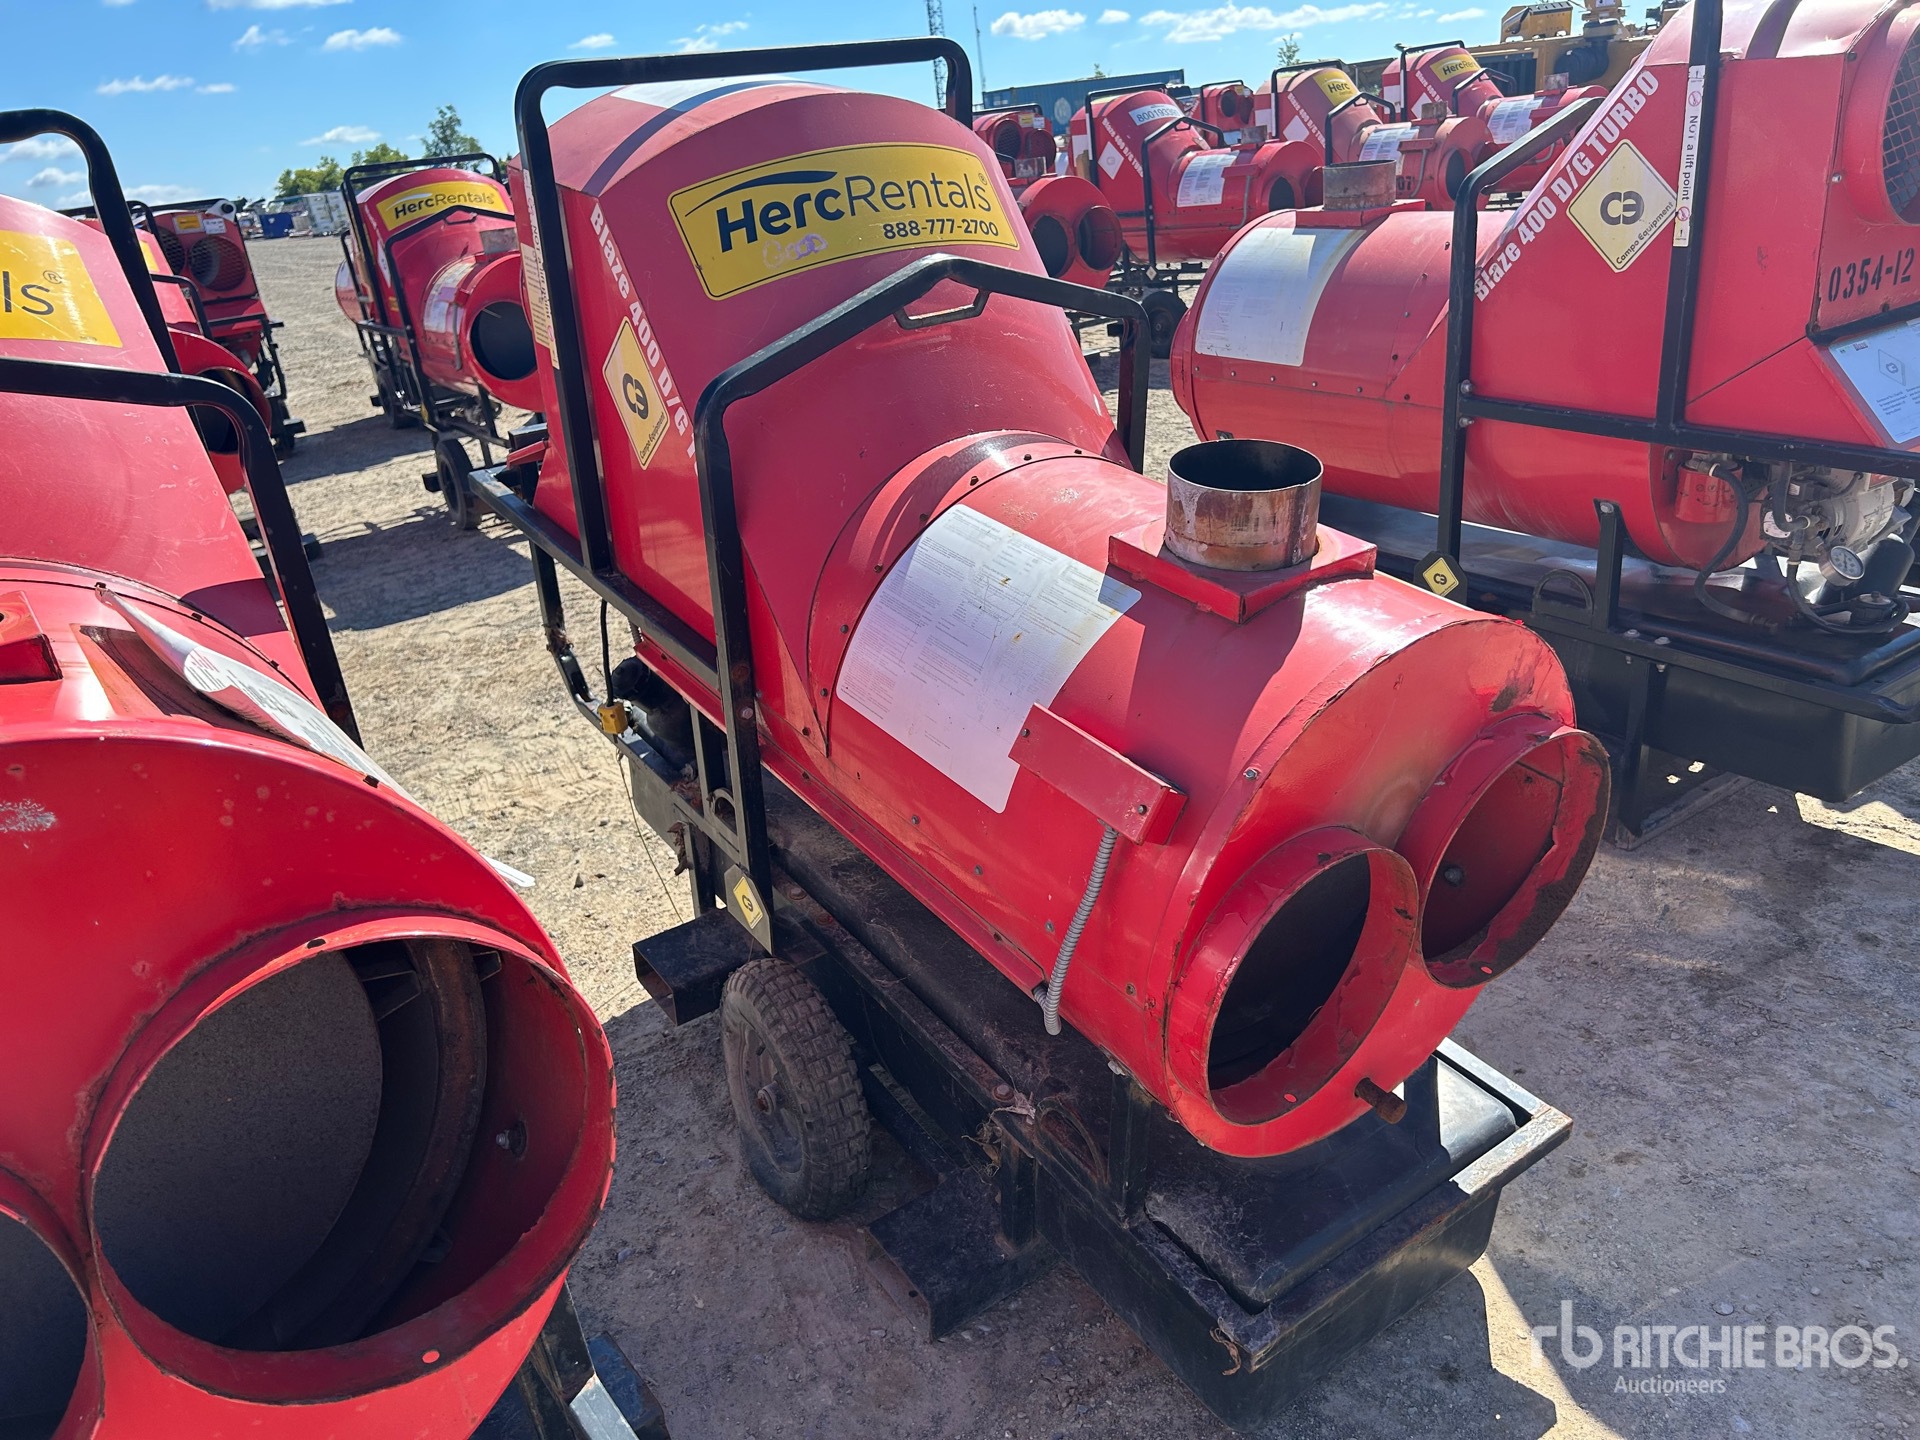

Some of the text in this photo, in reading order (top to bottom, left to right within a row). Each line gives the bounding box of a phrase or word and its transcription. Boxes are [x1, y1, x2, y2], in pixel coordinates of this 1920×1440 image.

[1474, 70, 1660, 302] Blaze 400 D/G TURBO
[1681, 115, 1699, 201] NOT a lift point
[883, 218, 999, 241] 888-777-2700
[1616, 201, 1674, 264] Campo Equipment
[1828, 247, 1915, 302] 0354-12
[590, 203, 689, 437] Blaze 400 D/G
